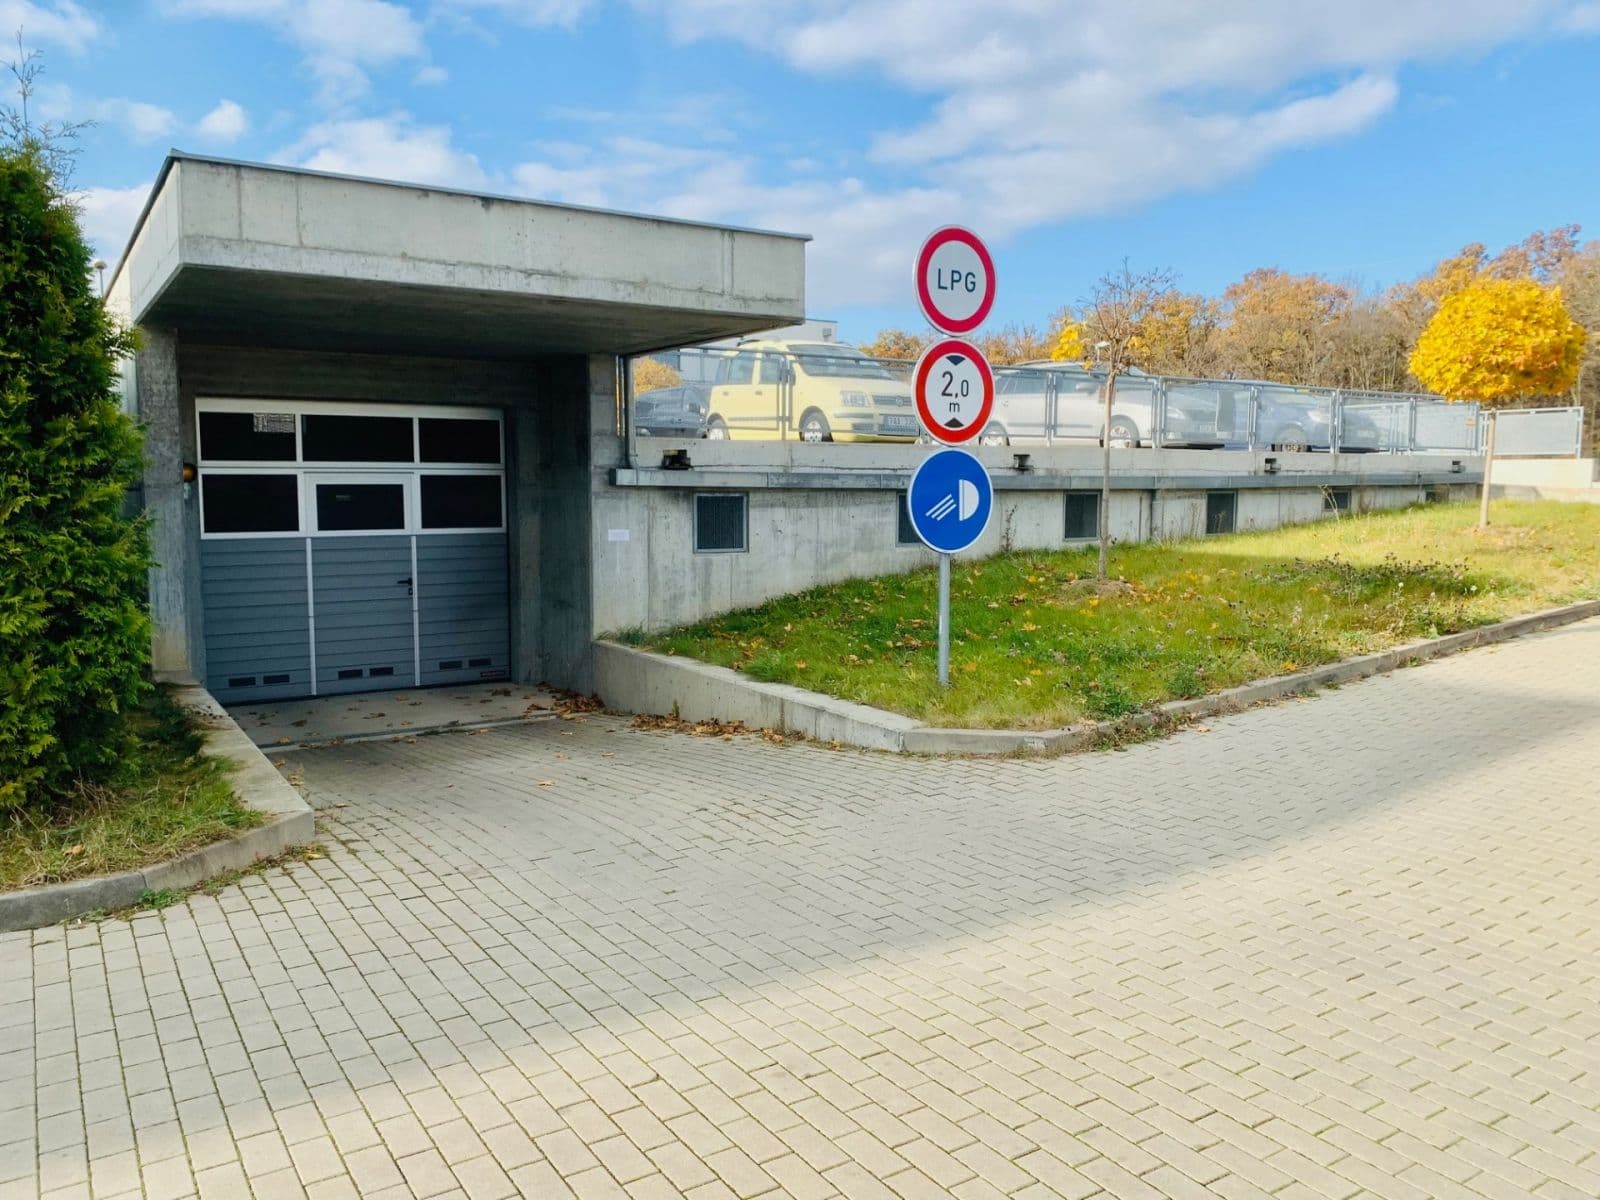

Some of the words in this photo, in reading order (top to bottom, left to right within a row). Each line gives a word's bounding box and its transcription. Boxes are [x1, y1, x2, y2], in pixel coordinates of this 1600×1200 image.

[937, 267, 977, 294] LPG
[940, 370, 970, 400] 2,0
[948, 401, 961, 413] m
